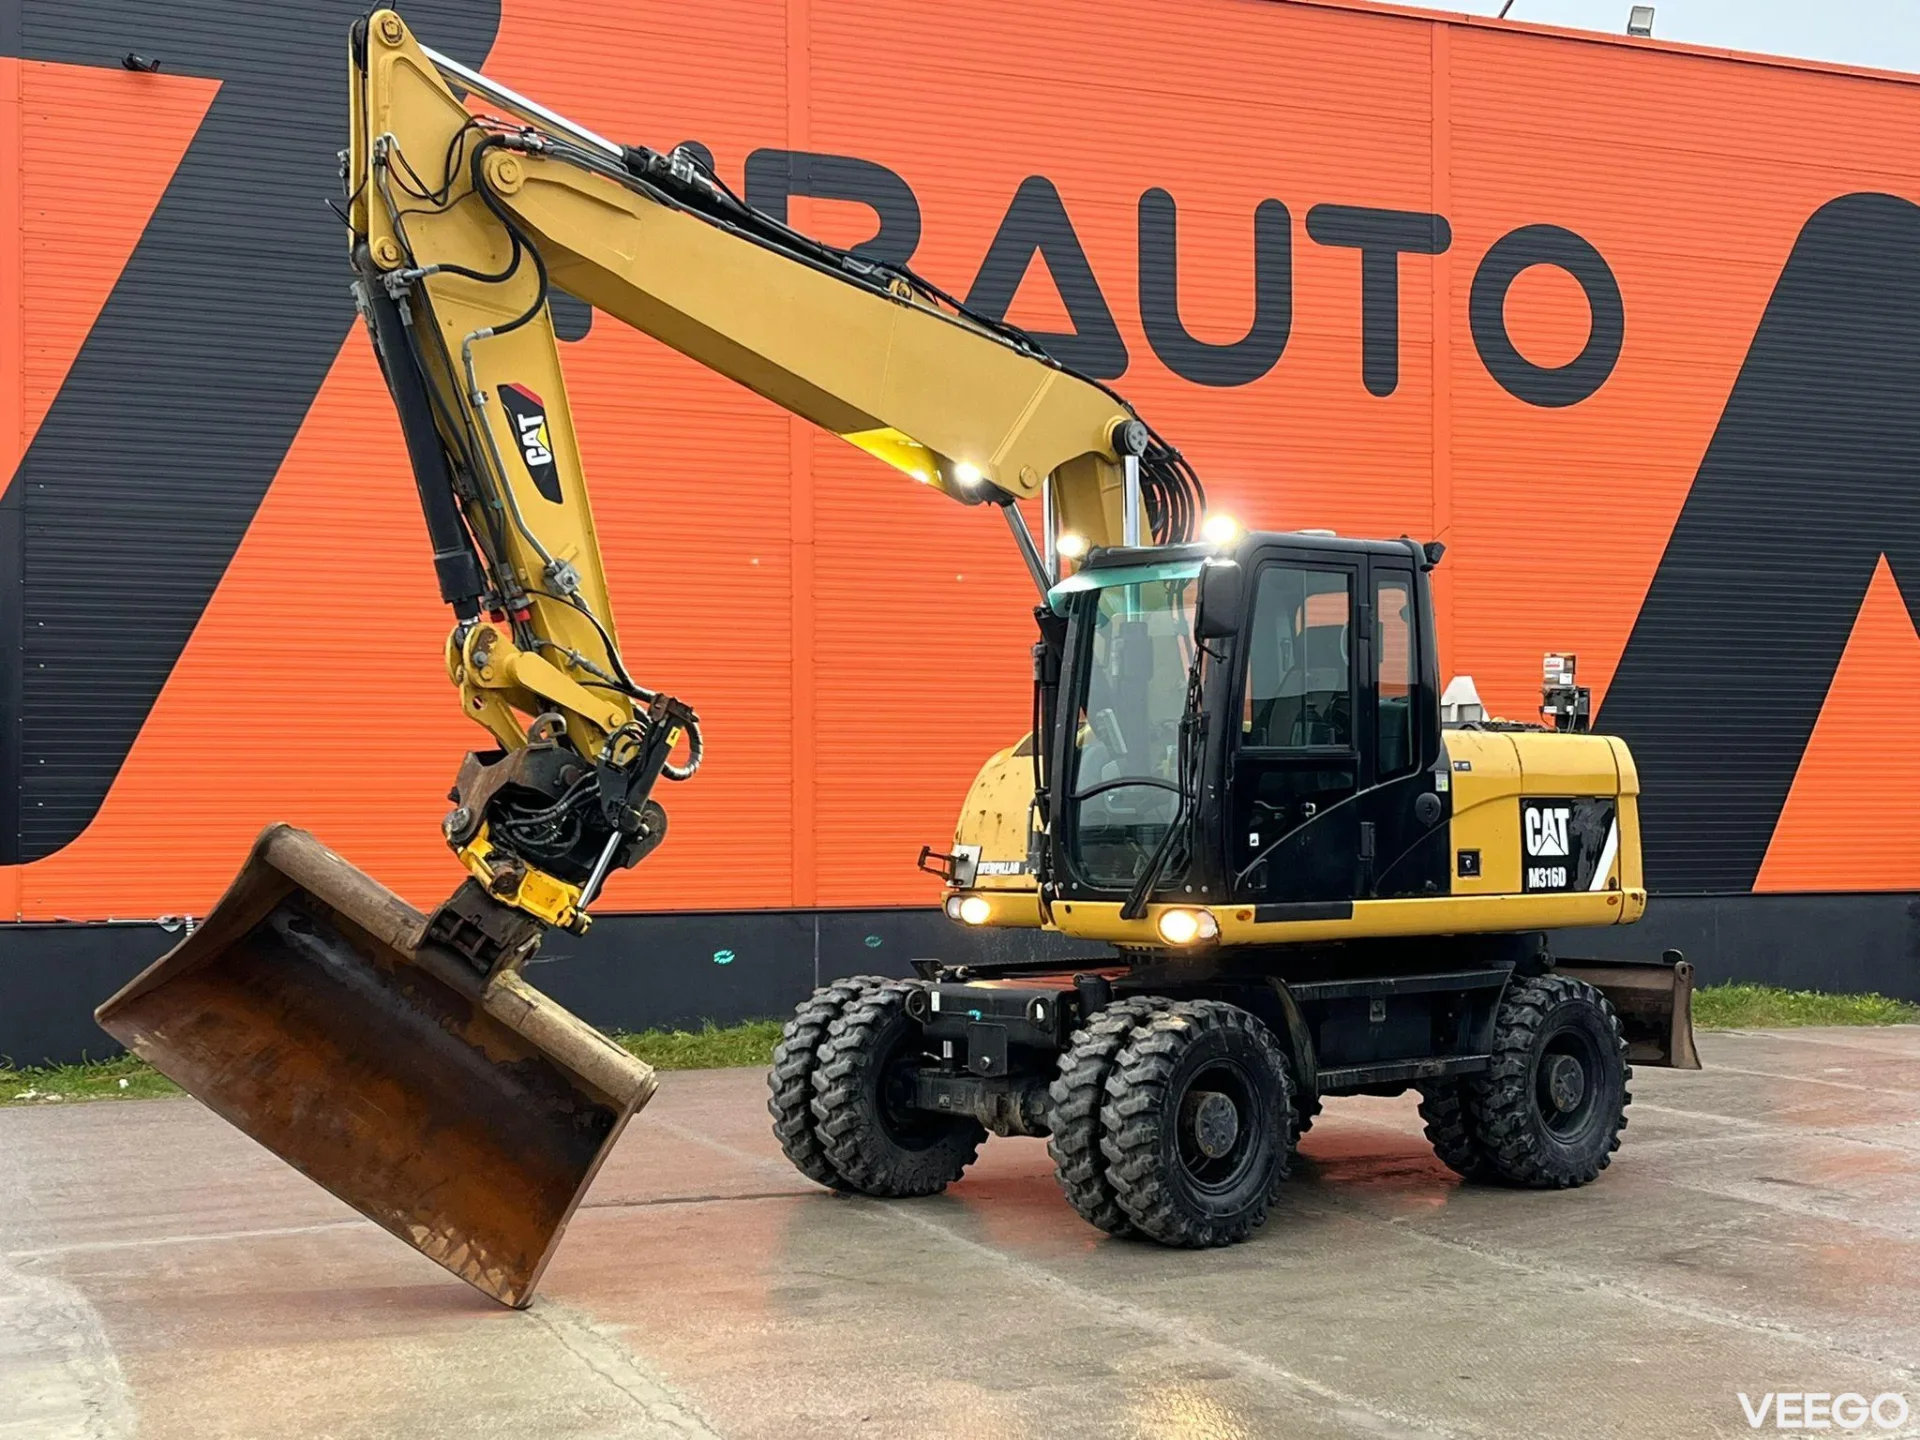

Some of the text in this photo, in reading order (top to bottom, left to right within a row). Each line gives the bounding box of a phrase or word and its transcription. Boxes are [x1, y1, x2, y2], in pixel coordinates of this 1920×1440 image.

[517, 413, 552, 466] CAT
[1525, 807, 1569, 856] CAT
[1528, 866, 1567, 888] M316D
